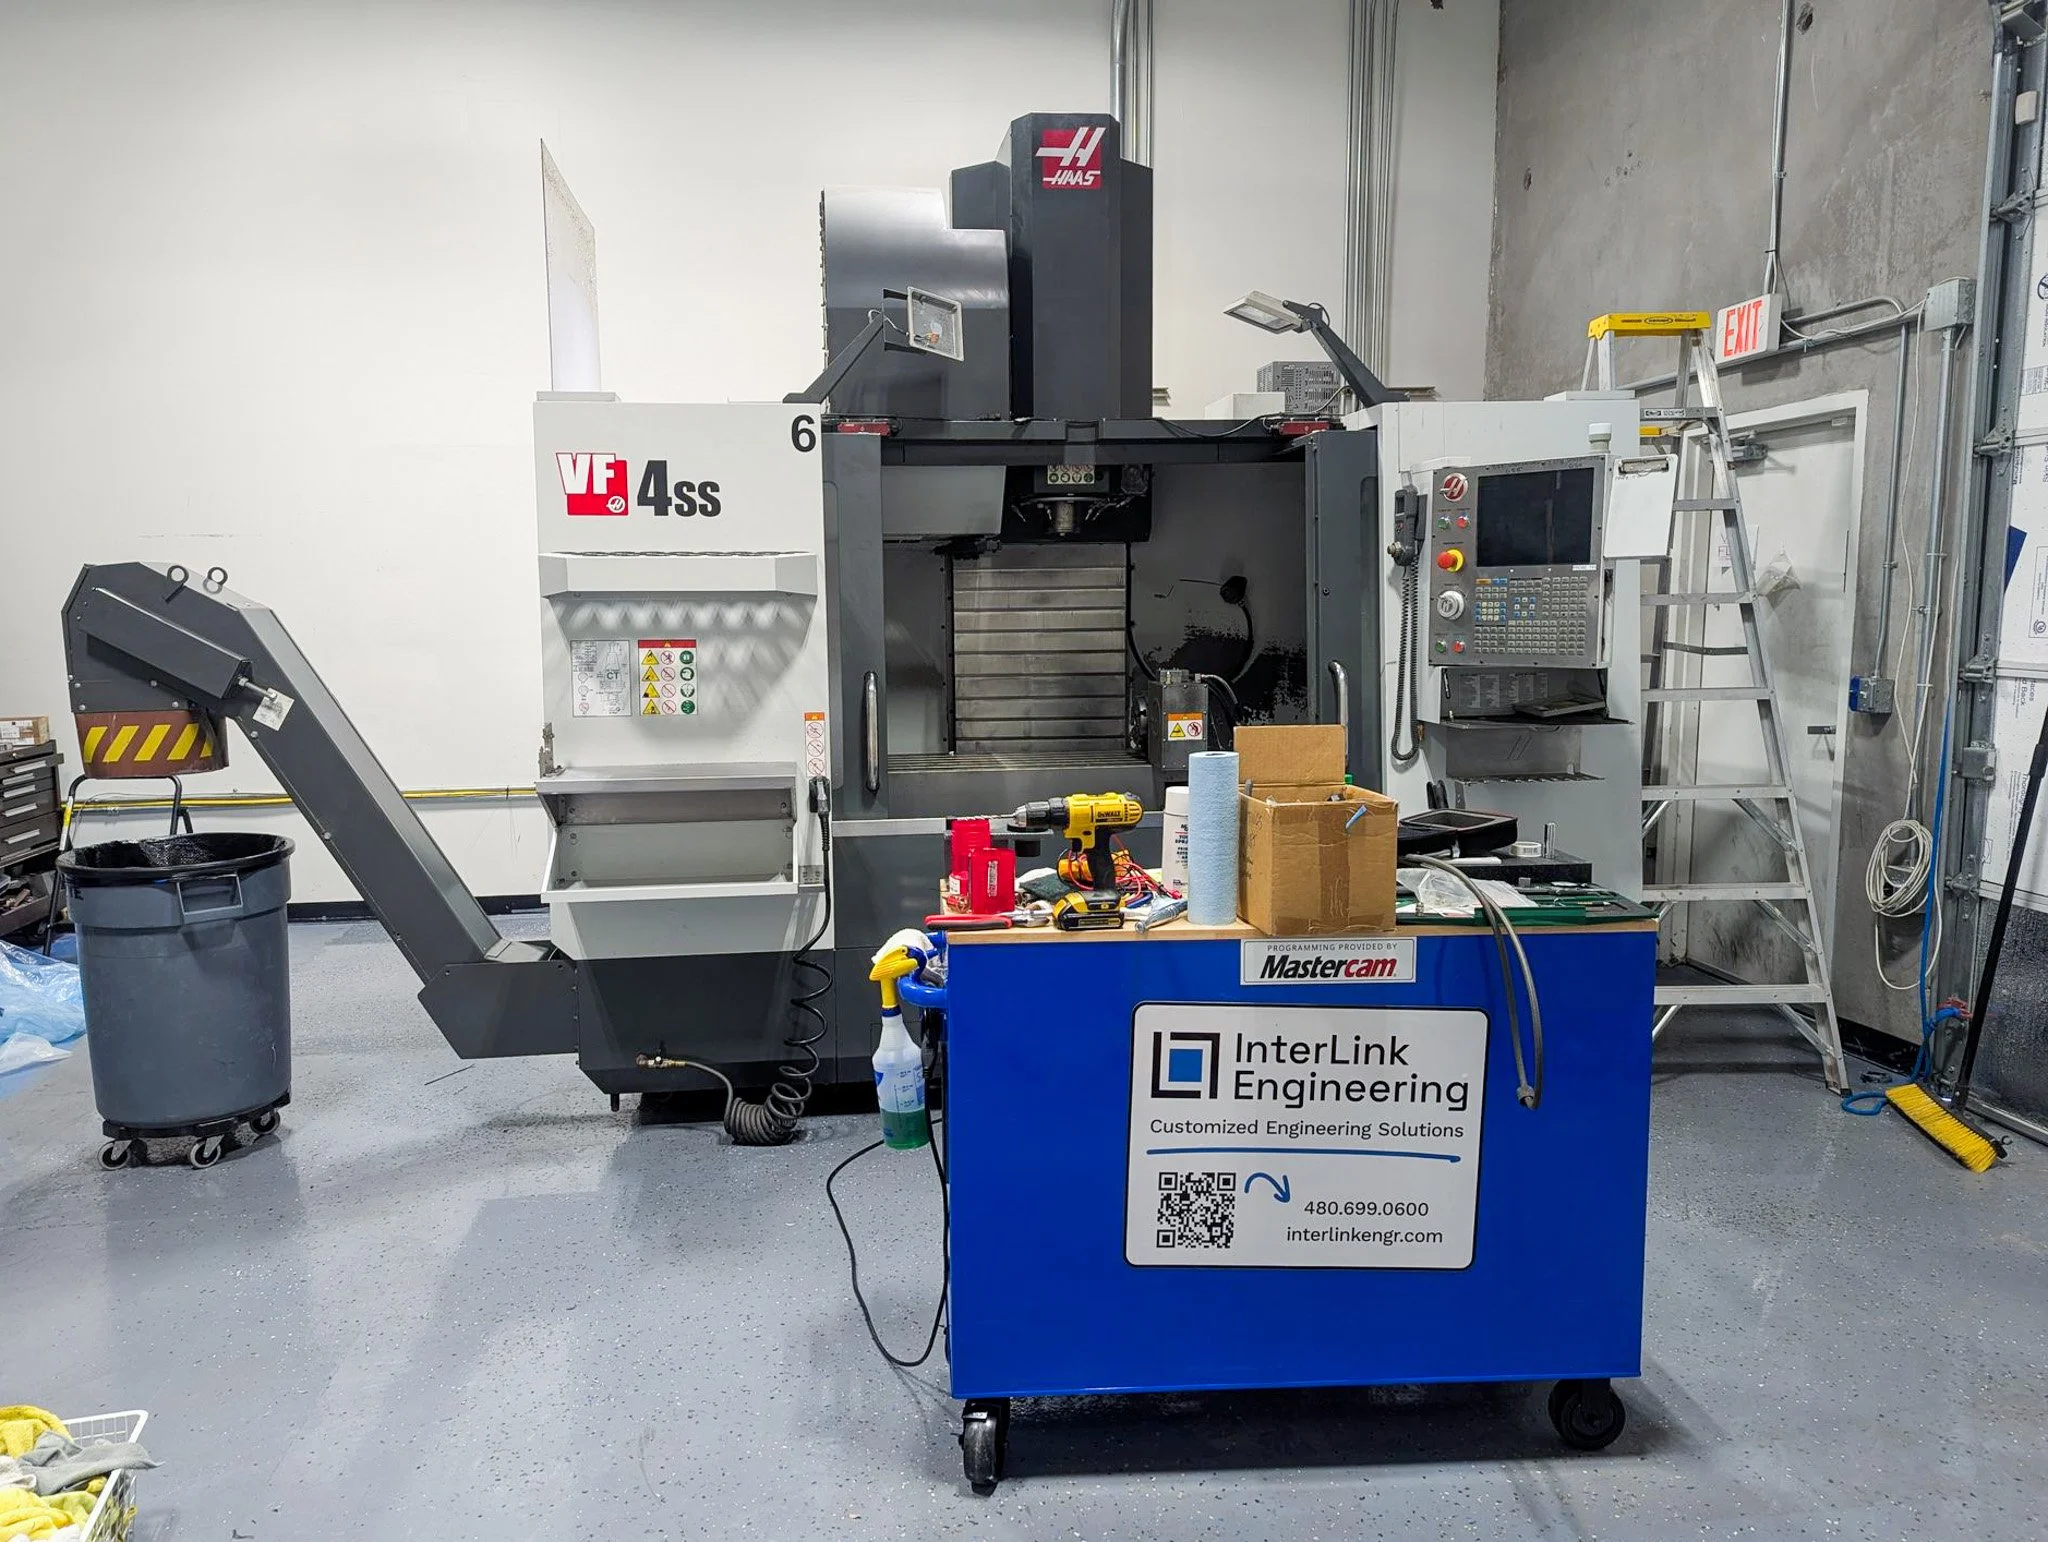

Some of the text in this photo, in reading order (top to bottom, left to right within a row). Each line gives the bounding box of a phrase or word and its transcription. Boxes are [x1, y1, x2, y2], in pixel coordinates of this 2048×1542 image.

[1043, 170, 1101, 185] HAAS
[1723, 299, 1763, 357] EXIT
[791, 414, 817, 452] 6
[556, 452, 616, 495] VF
[1267, 943, 1336, 952] PROGRAMMING
[1338, 943, 1383, 951] PROVIDED
[1259, 954, 1397, 978] Mastercam
[1235, 1032, 1410, 1067] InterLink
[1234, 1070, 1469, 1112] Engineering
[1149, 1119, 1464, 1139] Customized Engineering Solutions
[1304, 1201, 1429, 1216] 480.699.0600
[1287, 1226, 1443, 1246] interlinkengr.com
